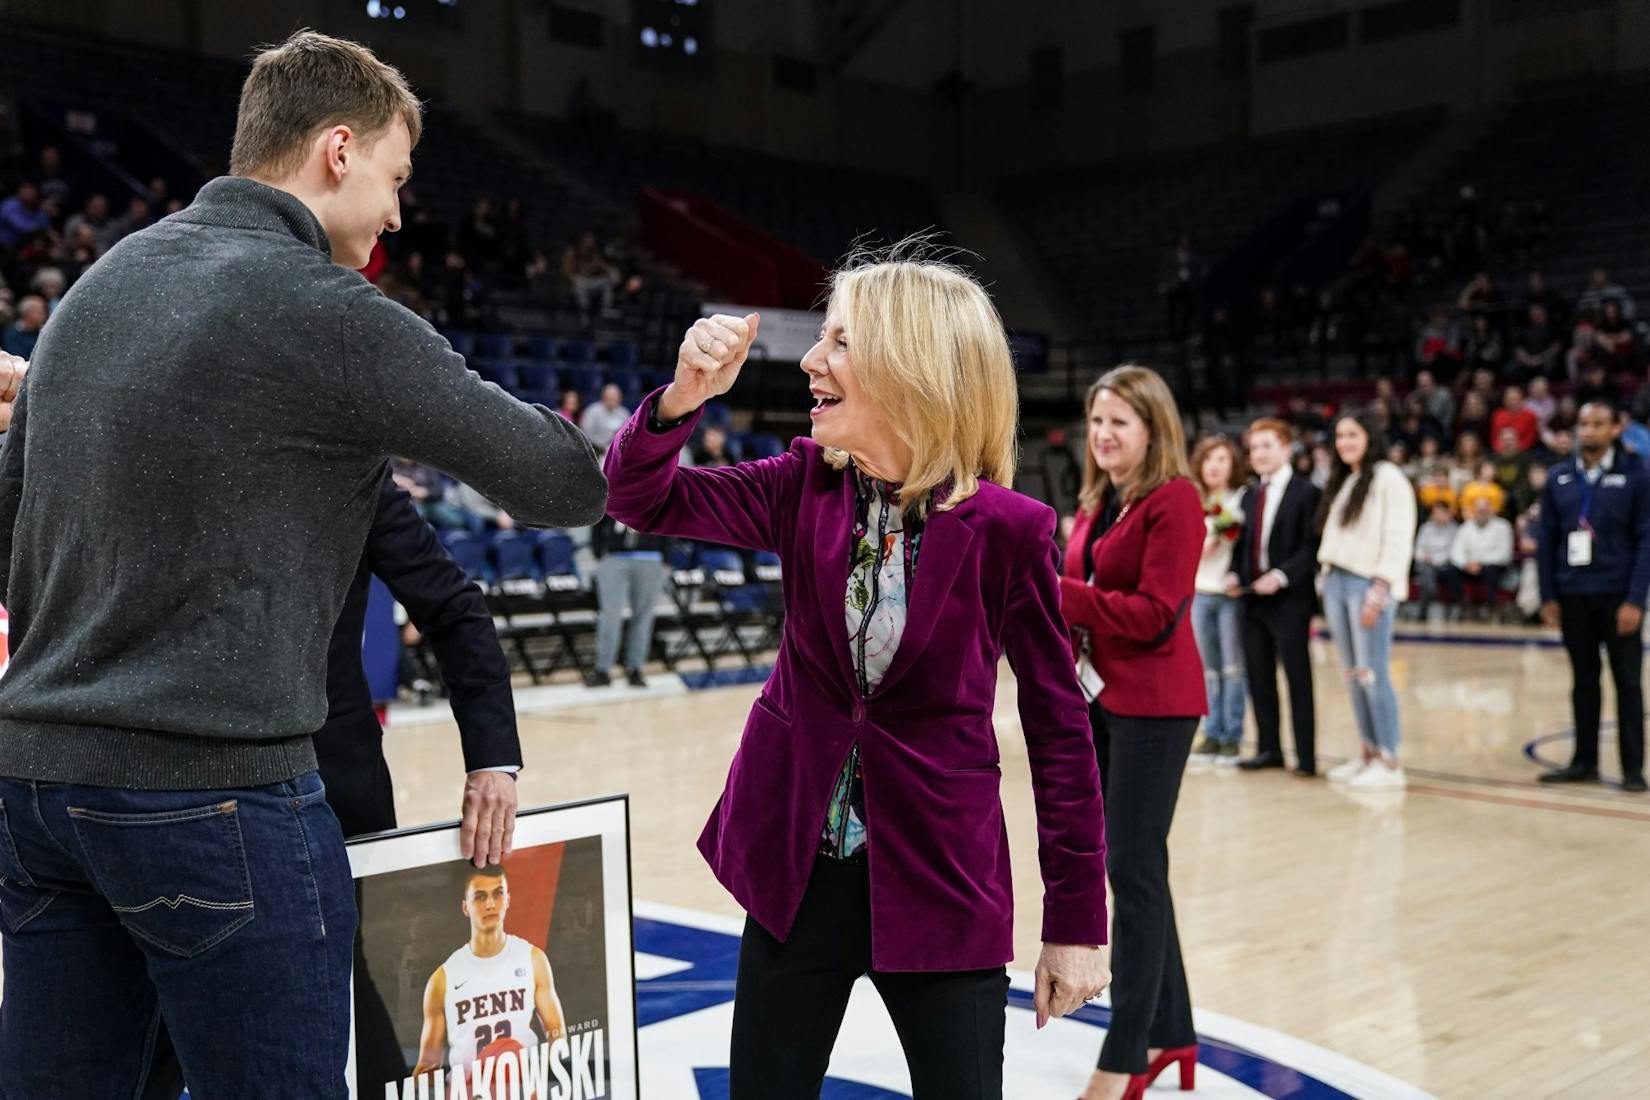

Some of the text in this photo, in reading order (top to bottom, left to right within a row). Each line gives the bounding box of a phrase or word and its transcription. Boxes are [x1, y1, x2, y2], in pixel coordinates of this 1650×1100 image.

[456, 988, 526, 1025] PENN
[546, 1019, 598, 1039] FOWARD
[385, 1029, 606, 1100] AKOWSKI
